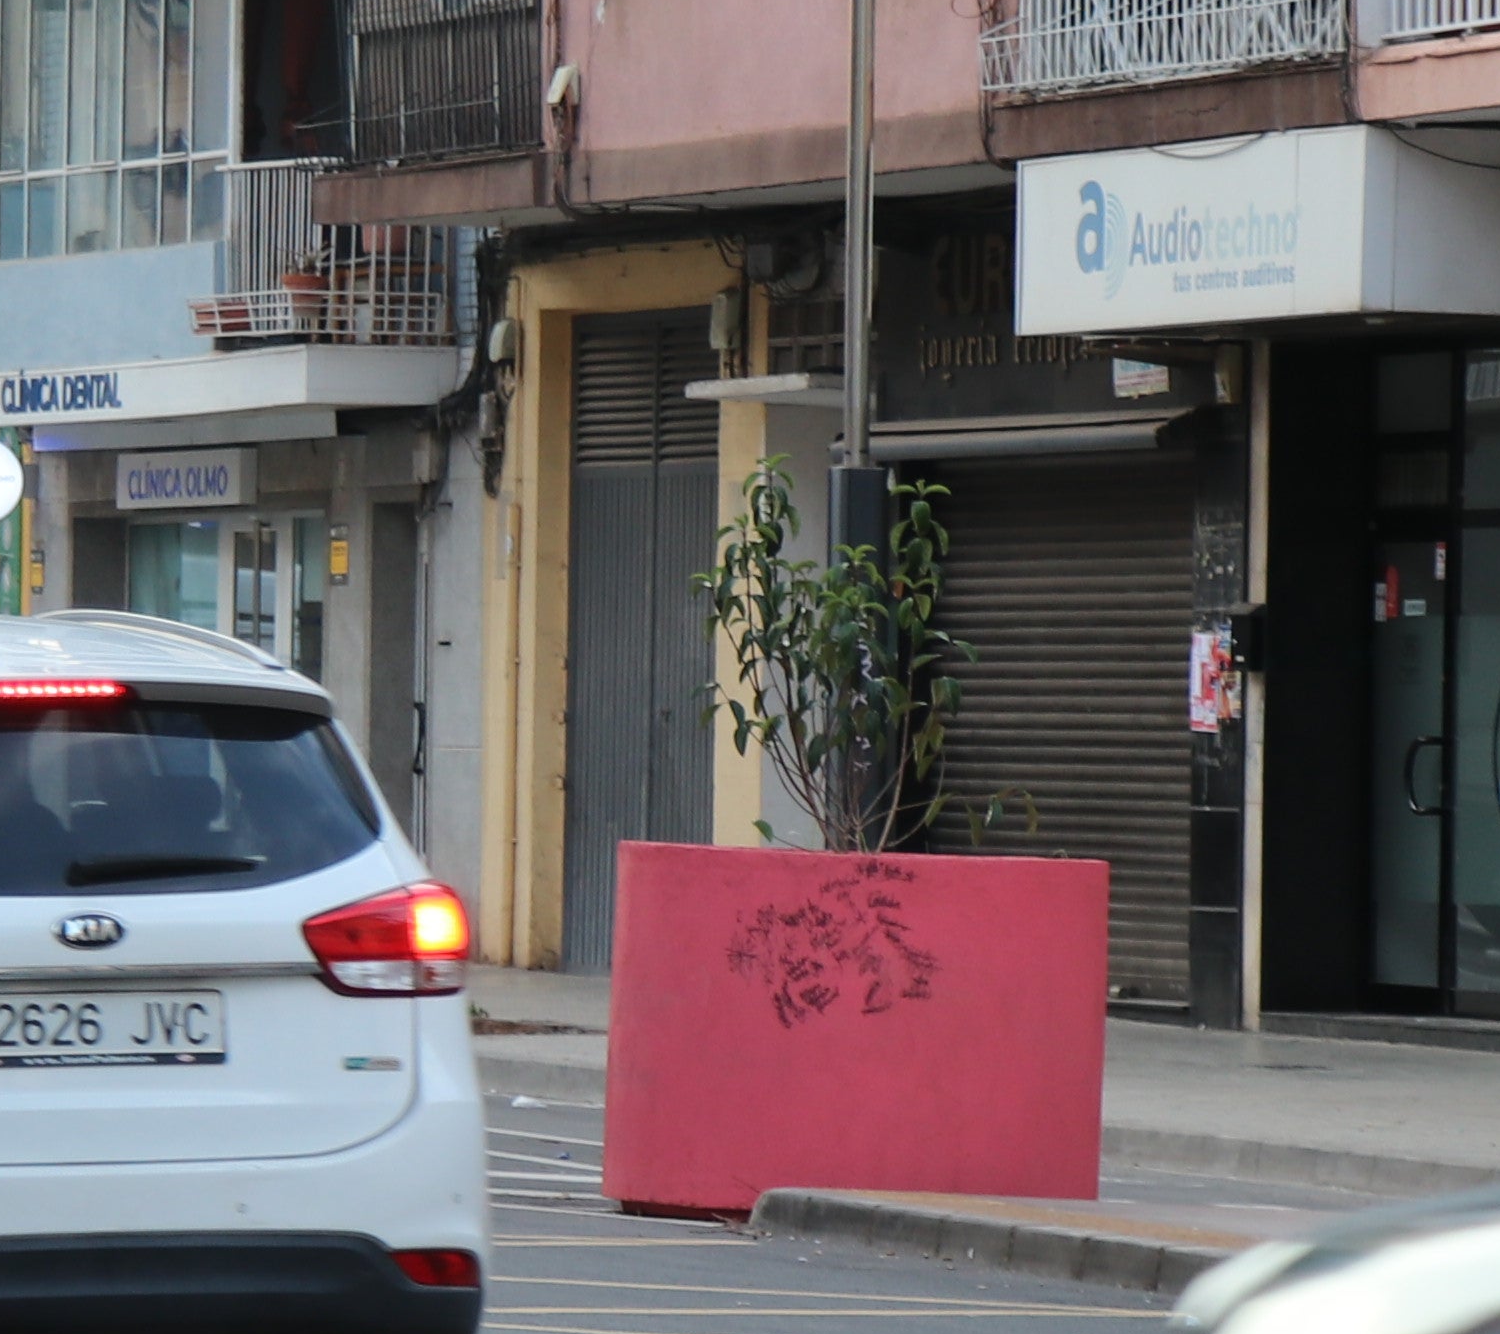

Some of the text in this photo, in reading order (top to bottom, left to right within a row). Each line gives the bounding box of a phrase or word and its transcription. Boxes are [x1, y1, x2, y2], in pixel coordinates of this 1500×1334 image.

[1, 369, 122, 414] CLÍNICA DENTAL
[128, 461, 229, 500] CLÍNICA OLMO
[62, 918, 121, 942] KIA
[131, 1002, 210, 1045] JVC
